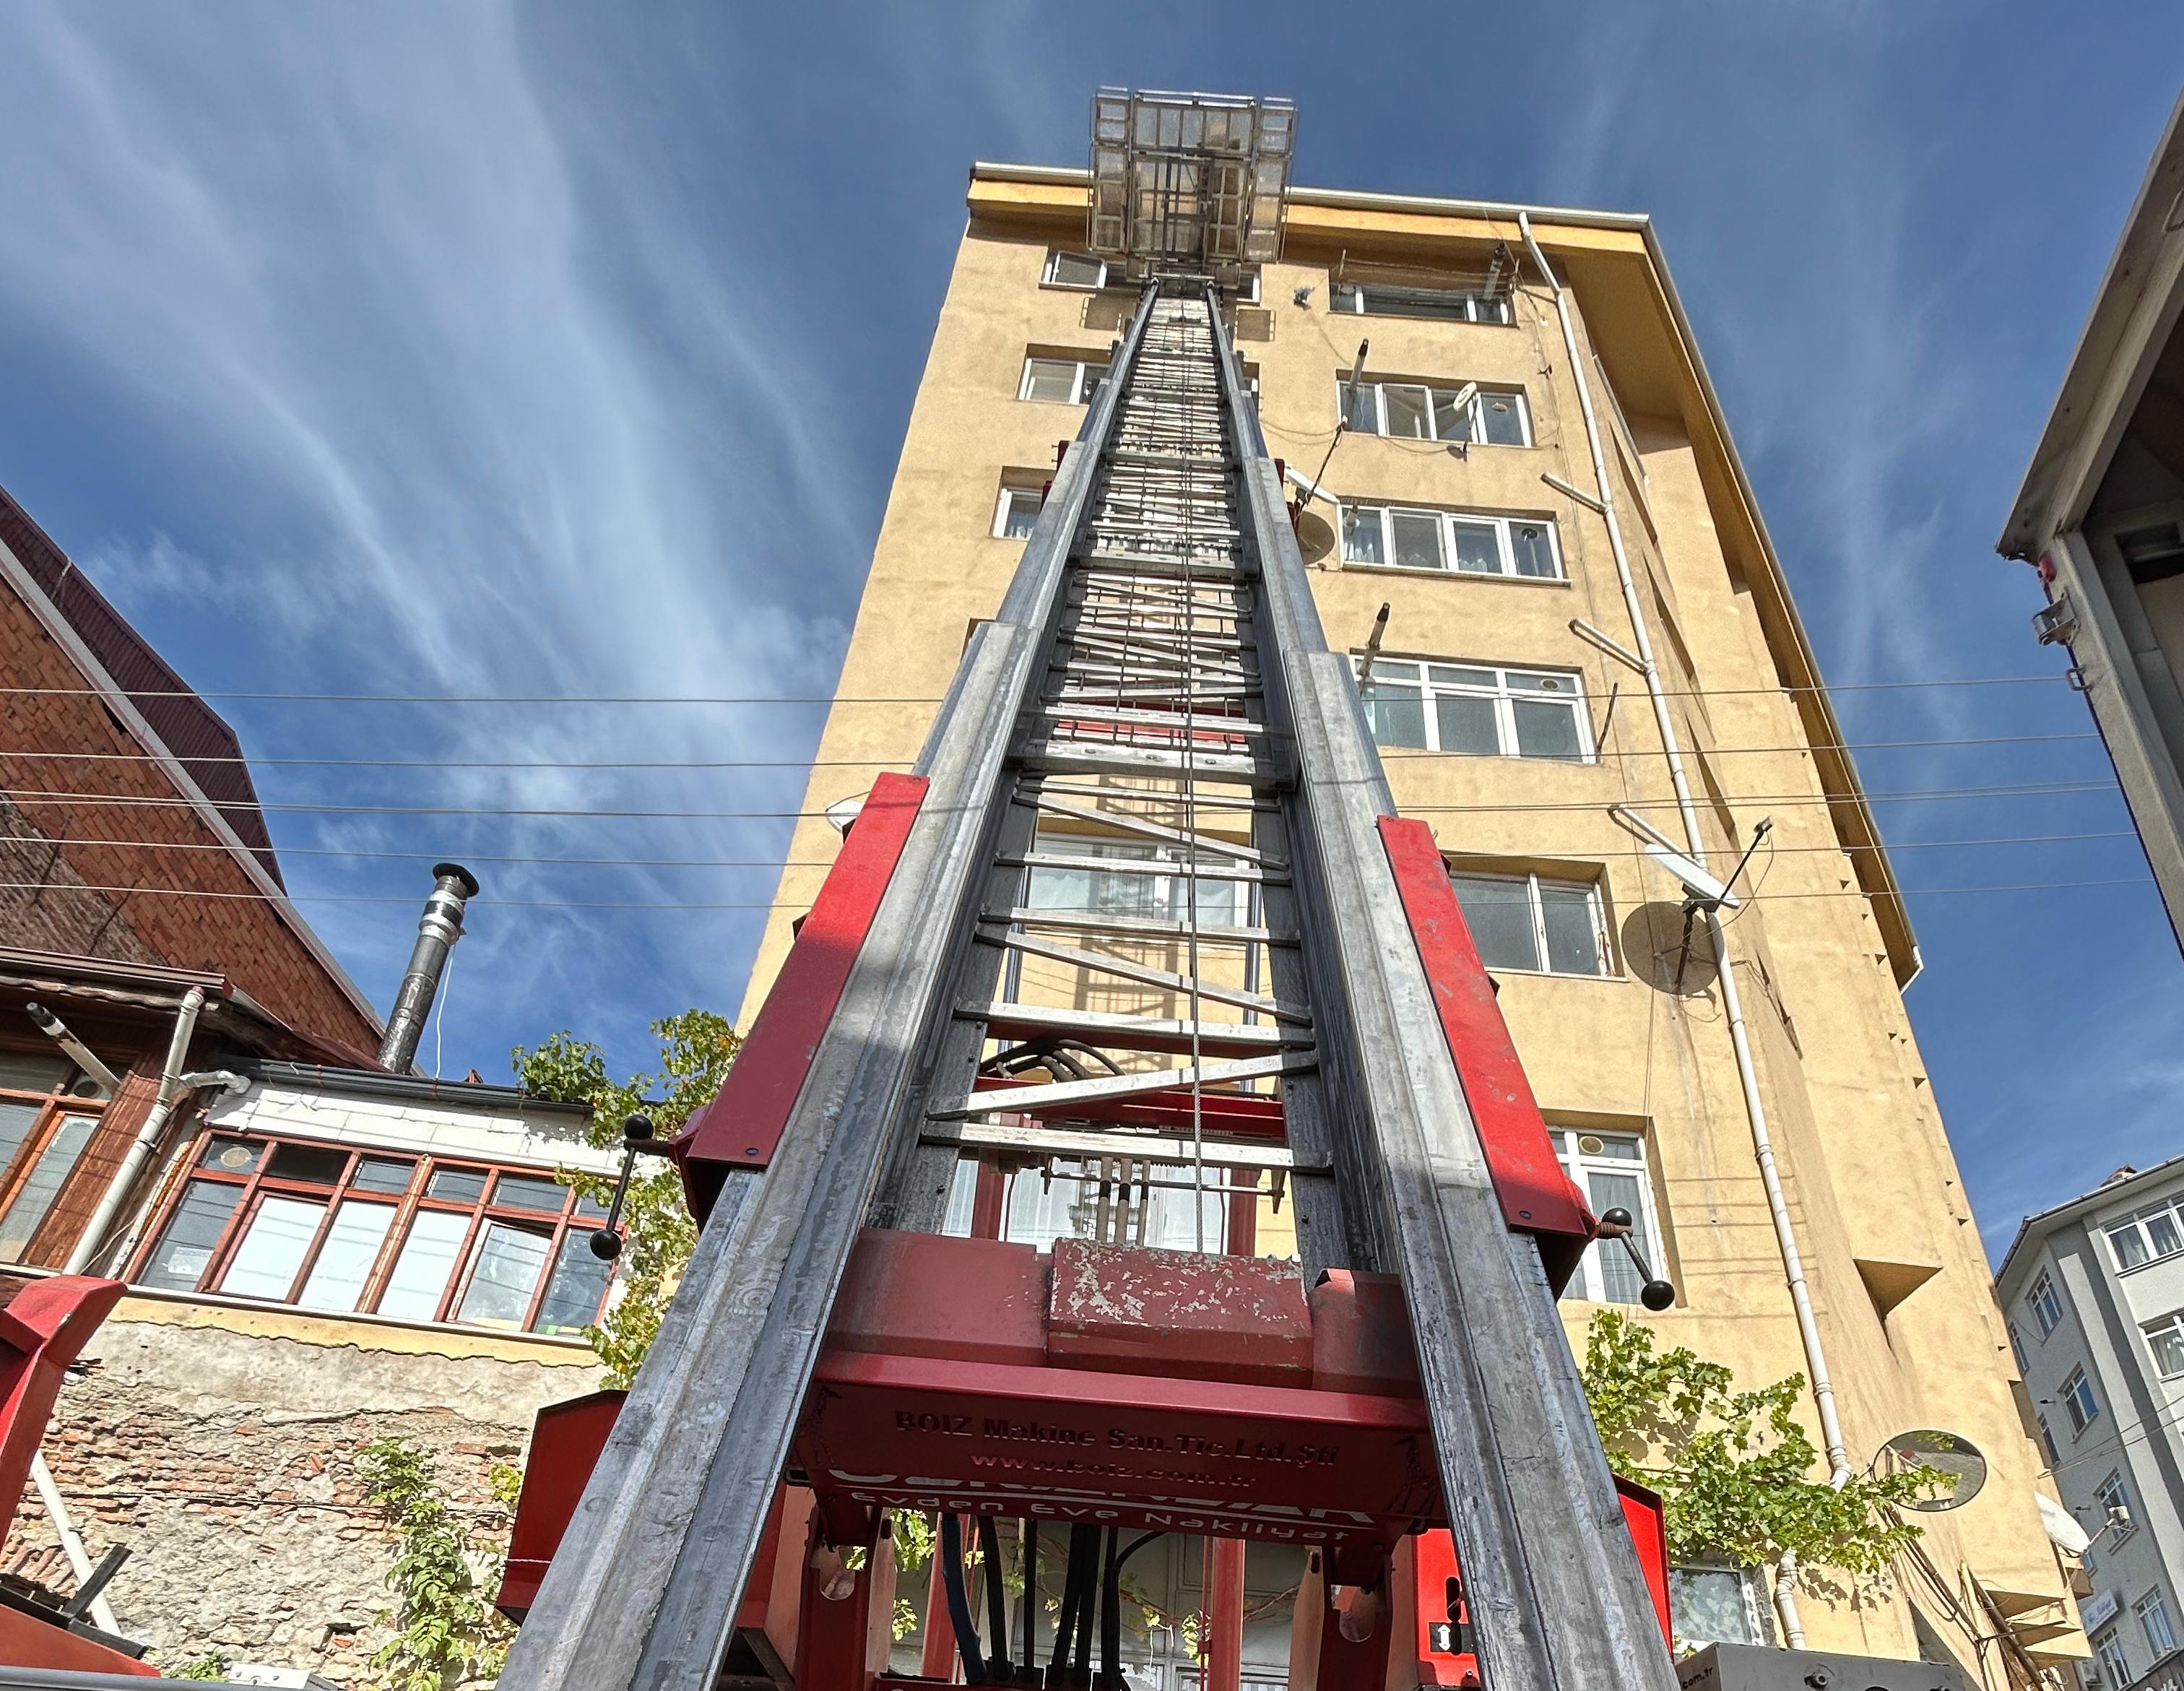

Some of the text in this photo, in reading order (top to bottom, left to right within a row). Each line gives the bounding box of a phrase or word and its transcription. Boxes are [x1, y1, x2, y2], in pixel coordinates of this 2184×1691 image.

[984, 1417, 1097, 1446] Makine
[971, 1454, 1257, 1488] www.boiz.com.tr
[851, 1491, 1349, 1539] Evden Eve Nakliyat
